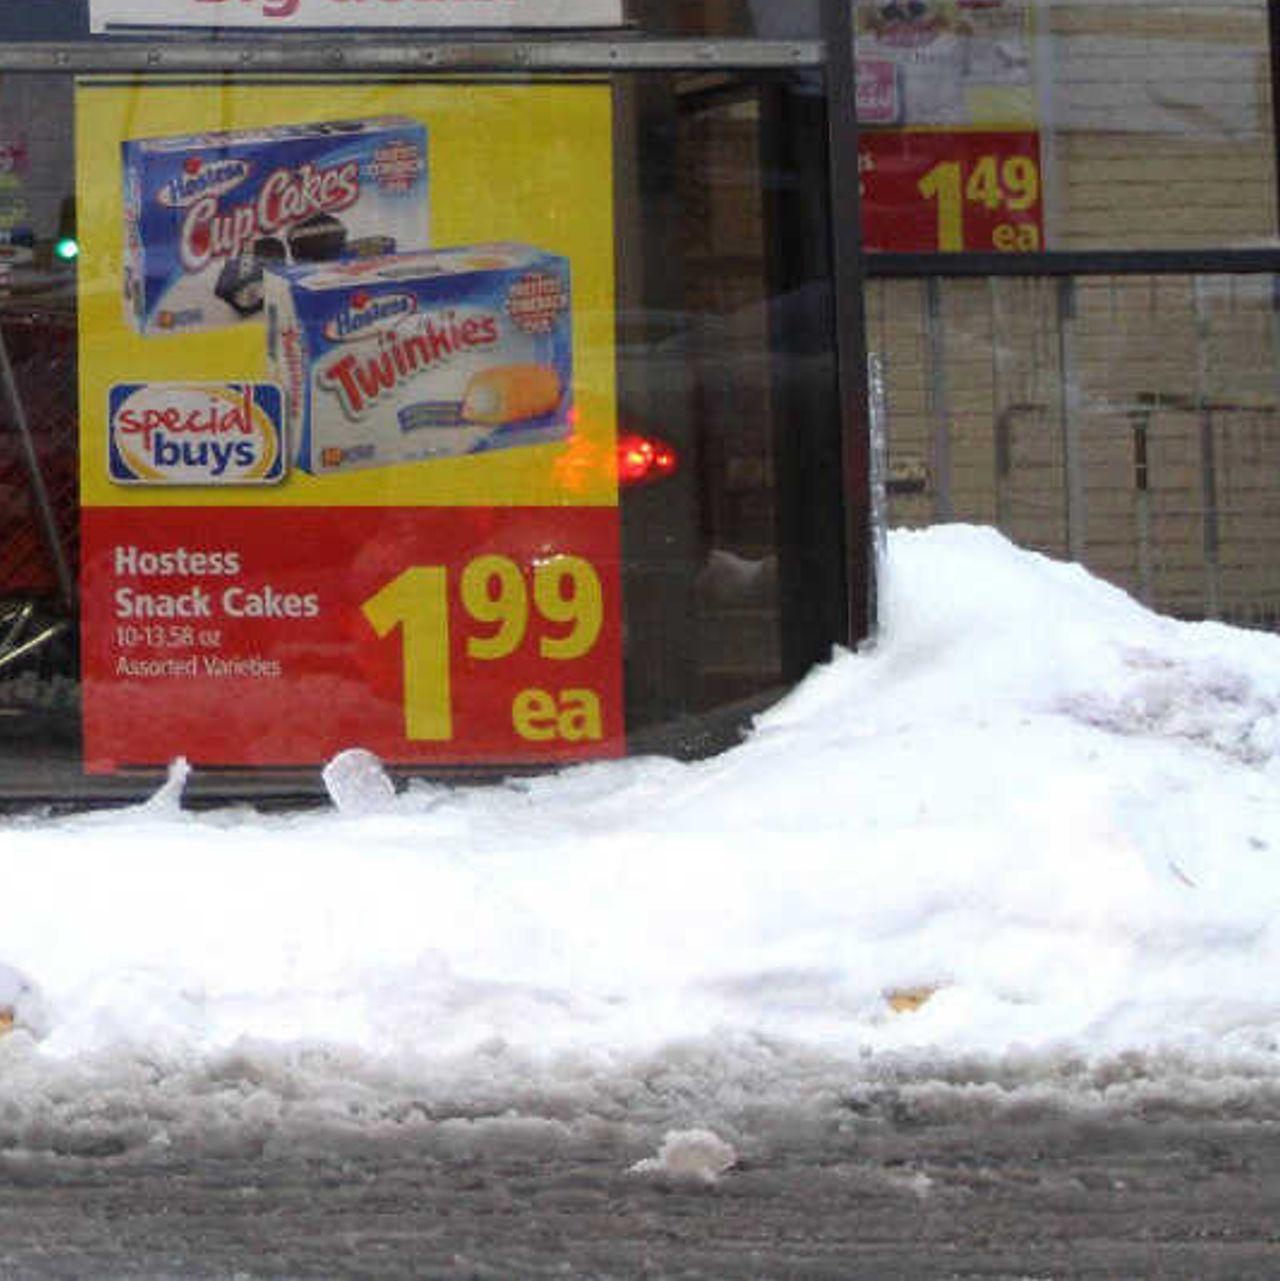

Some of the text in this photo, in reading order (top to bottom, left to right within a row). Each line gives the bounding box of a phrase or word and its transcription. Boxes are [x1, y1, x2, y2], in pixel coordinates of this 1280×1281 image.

[991, 223, 1039, 251] ea
[326, 310, 498, 413] Twinkies
[119, 384, 253, 451] special
[154, 431, 255, 476] buys
[114, 546, 241, 576] Hostess
[114, 584, 320, 618] Snack Cakes
[116, 655, 282, 677] Assorted Varieties
[510, 685, 604, 742] ea
